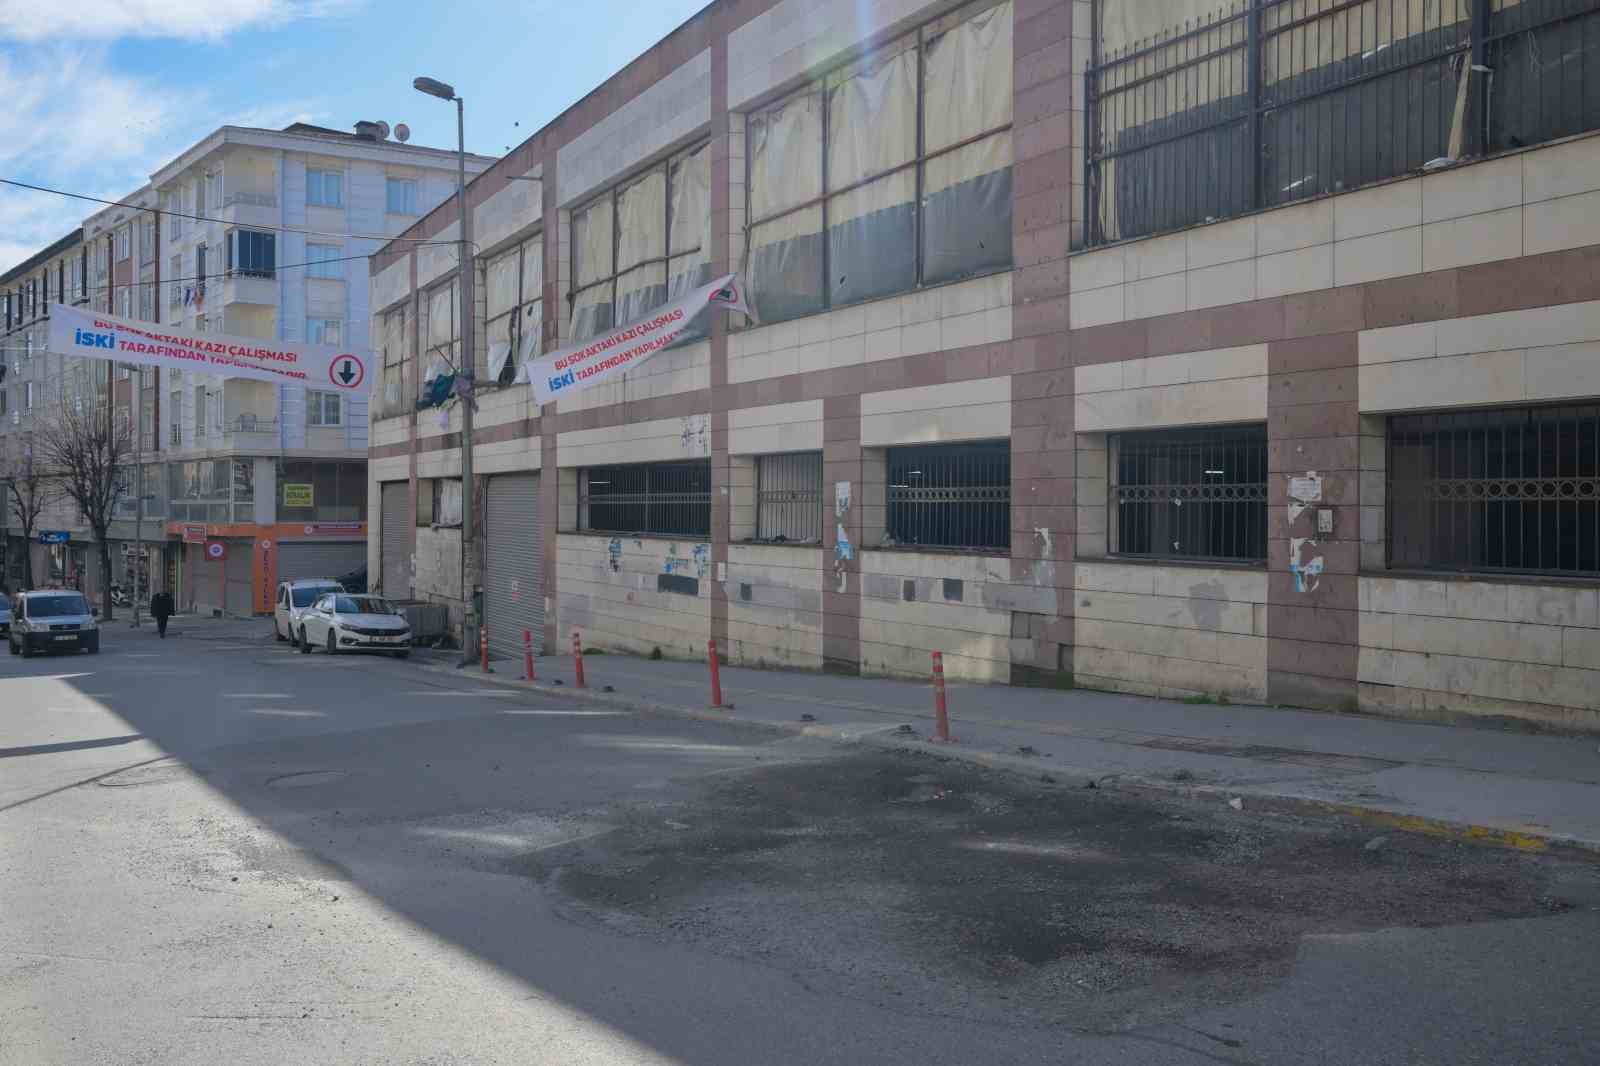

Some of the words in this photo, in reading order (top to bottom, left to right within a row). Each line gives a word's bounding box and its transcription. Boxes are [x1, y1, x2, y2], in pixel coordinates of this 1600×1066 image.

[75, 328, 115, 349] İSKİ
[119, 340, 206, 361] TARAFINDAN
[194, 338, 226, 354] KAZI
[227, 344, 298, 363] ÇALIŞMASI
[554, 358, 568, 370] BU
[567, 335, 616, 364] SOKAKTAKİ
[615, 328, 638, 344] KAZI
[637, 309, 684, 336] ÇALIŞMASI
[576, 350, 633, 380] TARAFINDAN
[548, 368, 575, 392] İSKİ
